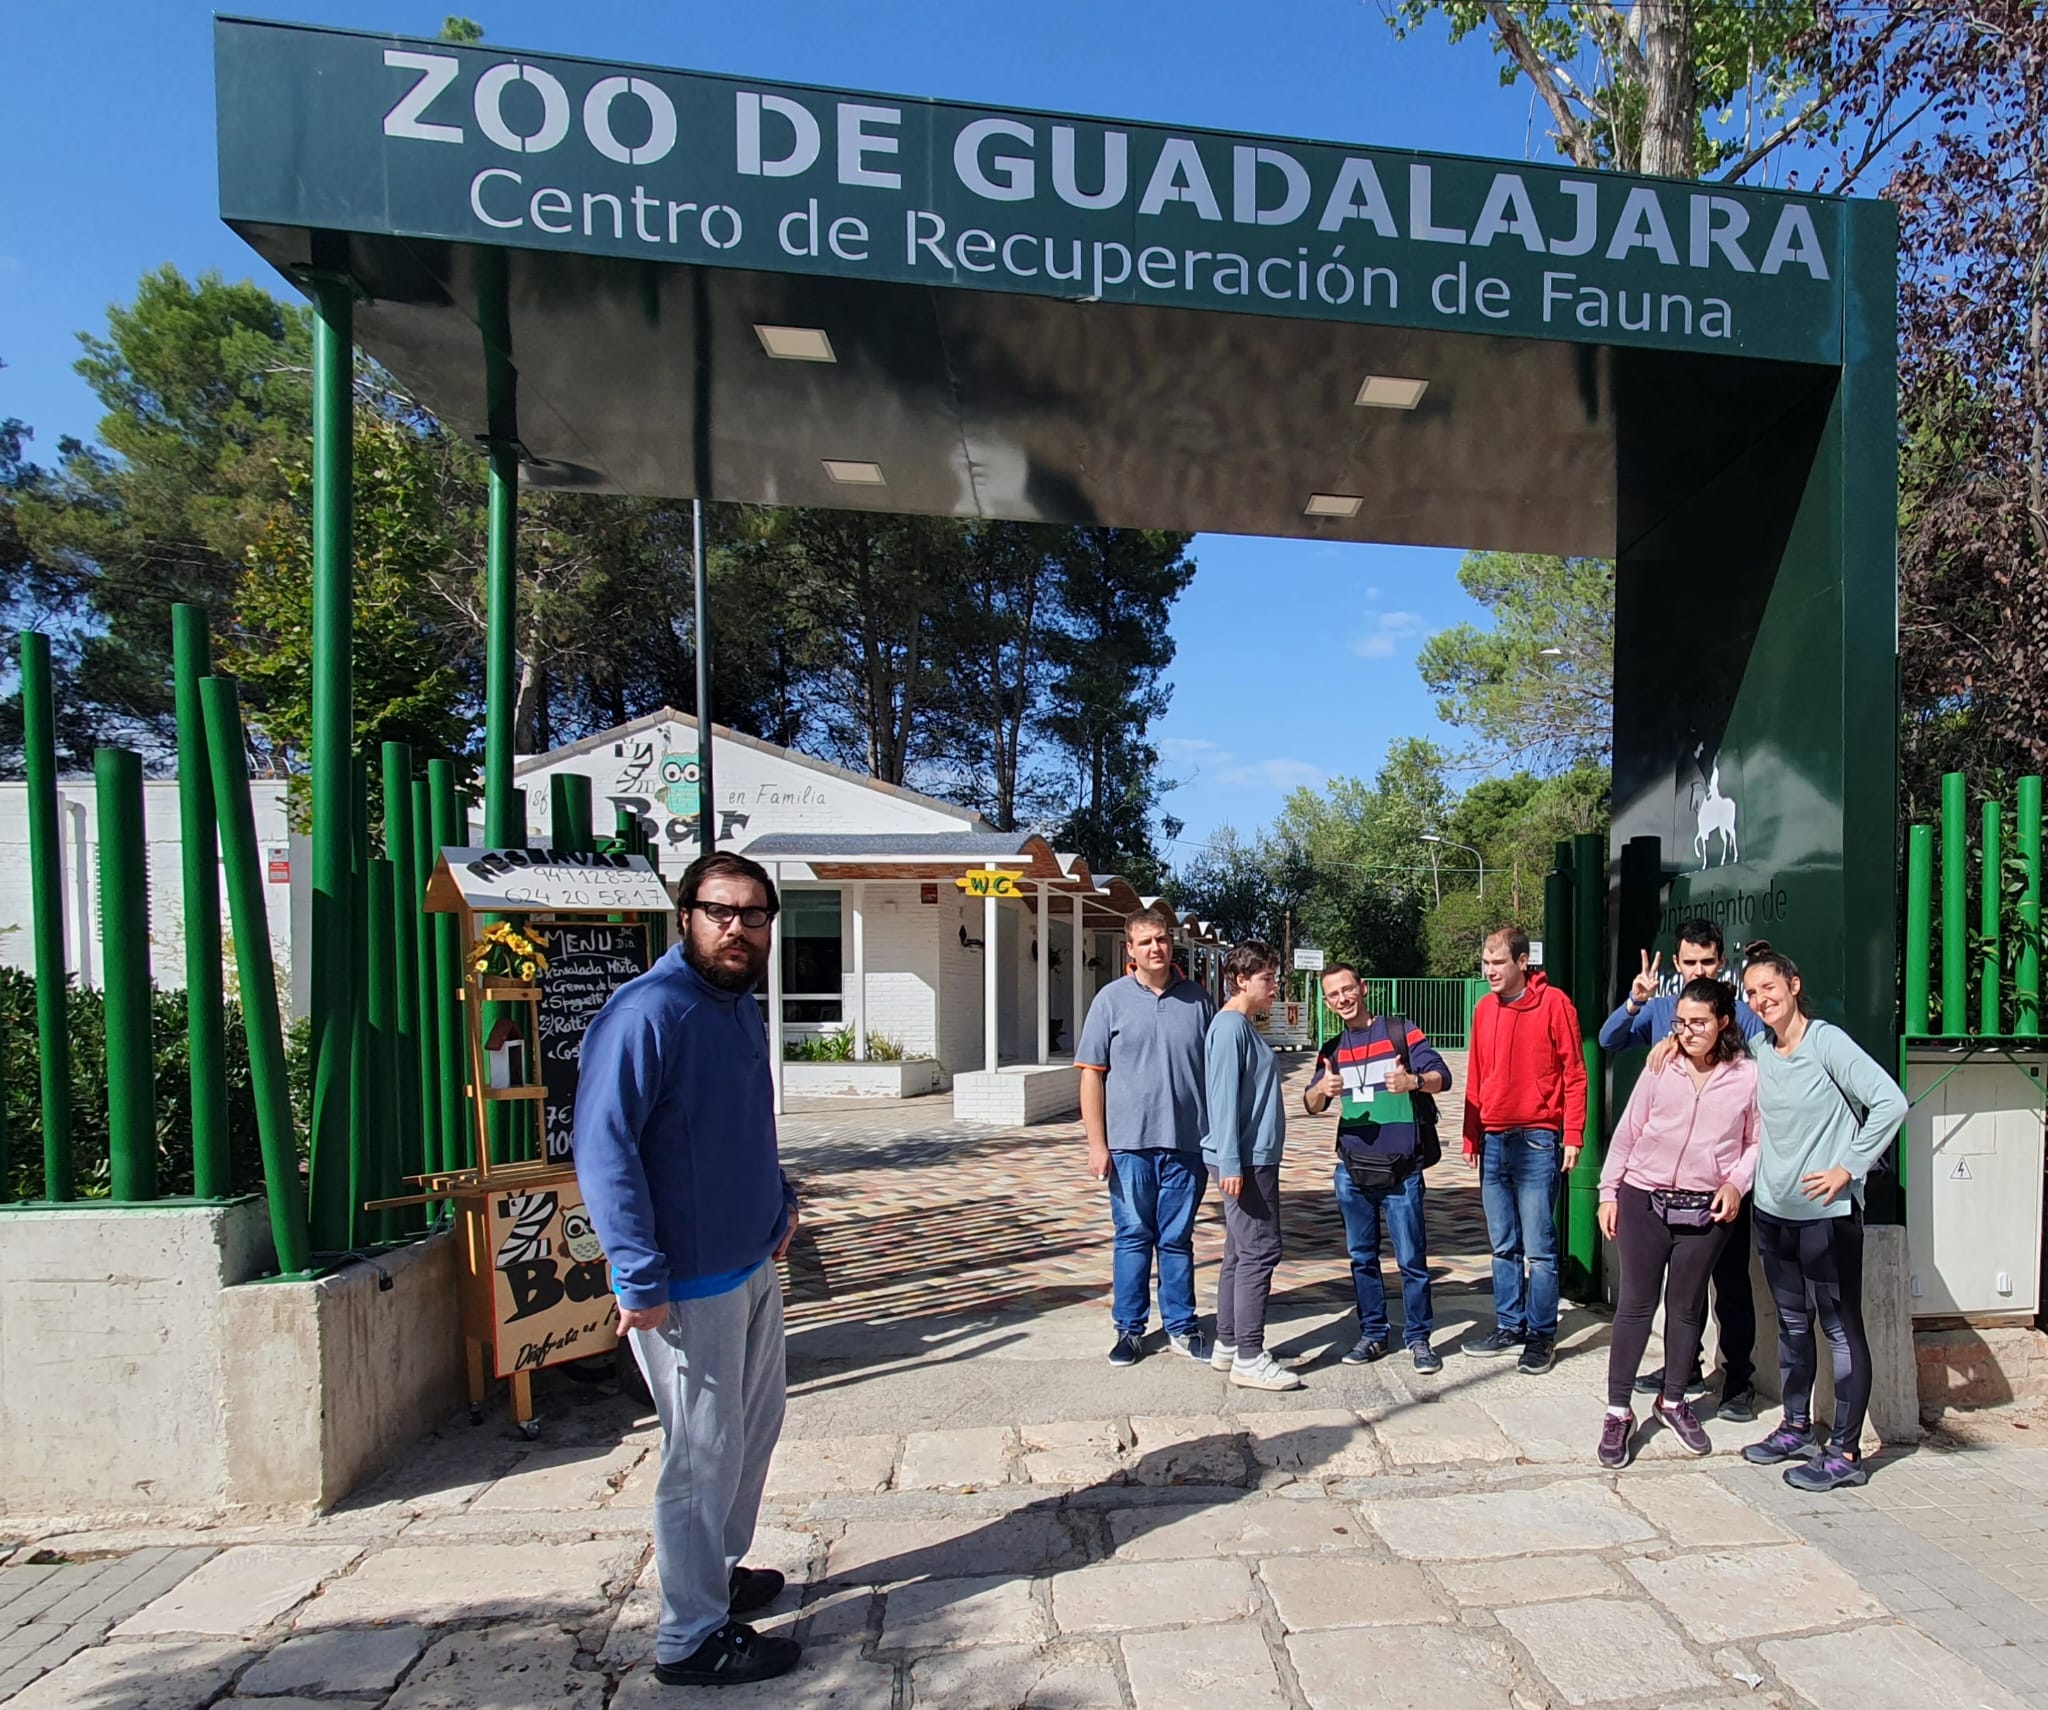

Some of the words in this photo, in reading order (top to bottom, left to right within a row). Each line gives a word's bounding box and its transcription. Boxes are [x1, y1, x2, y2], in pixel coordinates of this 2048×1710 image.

[382, 48, 678, 166] ZOO
[735, 91, 902, 190] DE
[953, 118, 1830, 282] GUADALAJARA
[470, 167, 743, 250] Centro
[778, 197, 869, 261] de
[905, 210, 1398, 309] Recuperación
[1432, 260, 1510, 319] de
[1542, 271, 1732, 339] Fauna
[728, 790, 745, 805] en
[756, 783, 827, 805] Familia
[466, 848, 630, 884] RESERVAS
[505, 888, 550, 905] 624
[562, 889, 590, 905] 20
[599, 889, 662, 906] 5817
[970, 876, 1011, 894] WC
[1762, 879, 1788, 922] de
[545, 929, 612, 961] MENU
[497, 1258, 618, 1324] Ba
